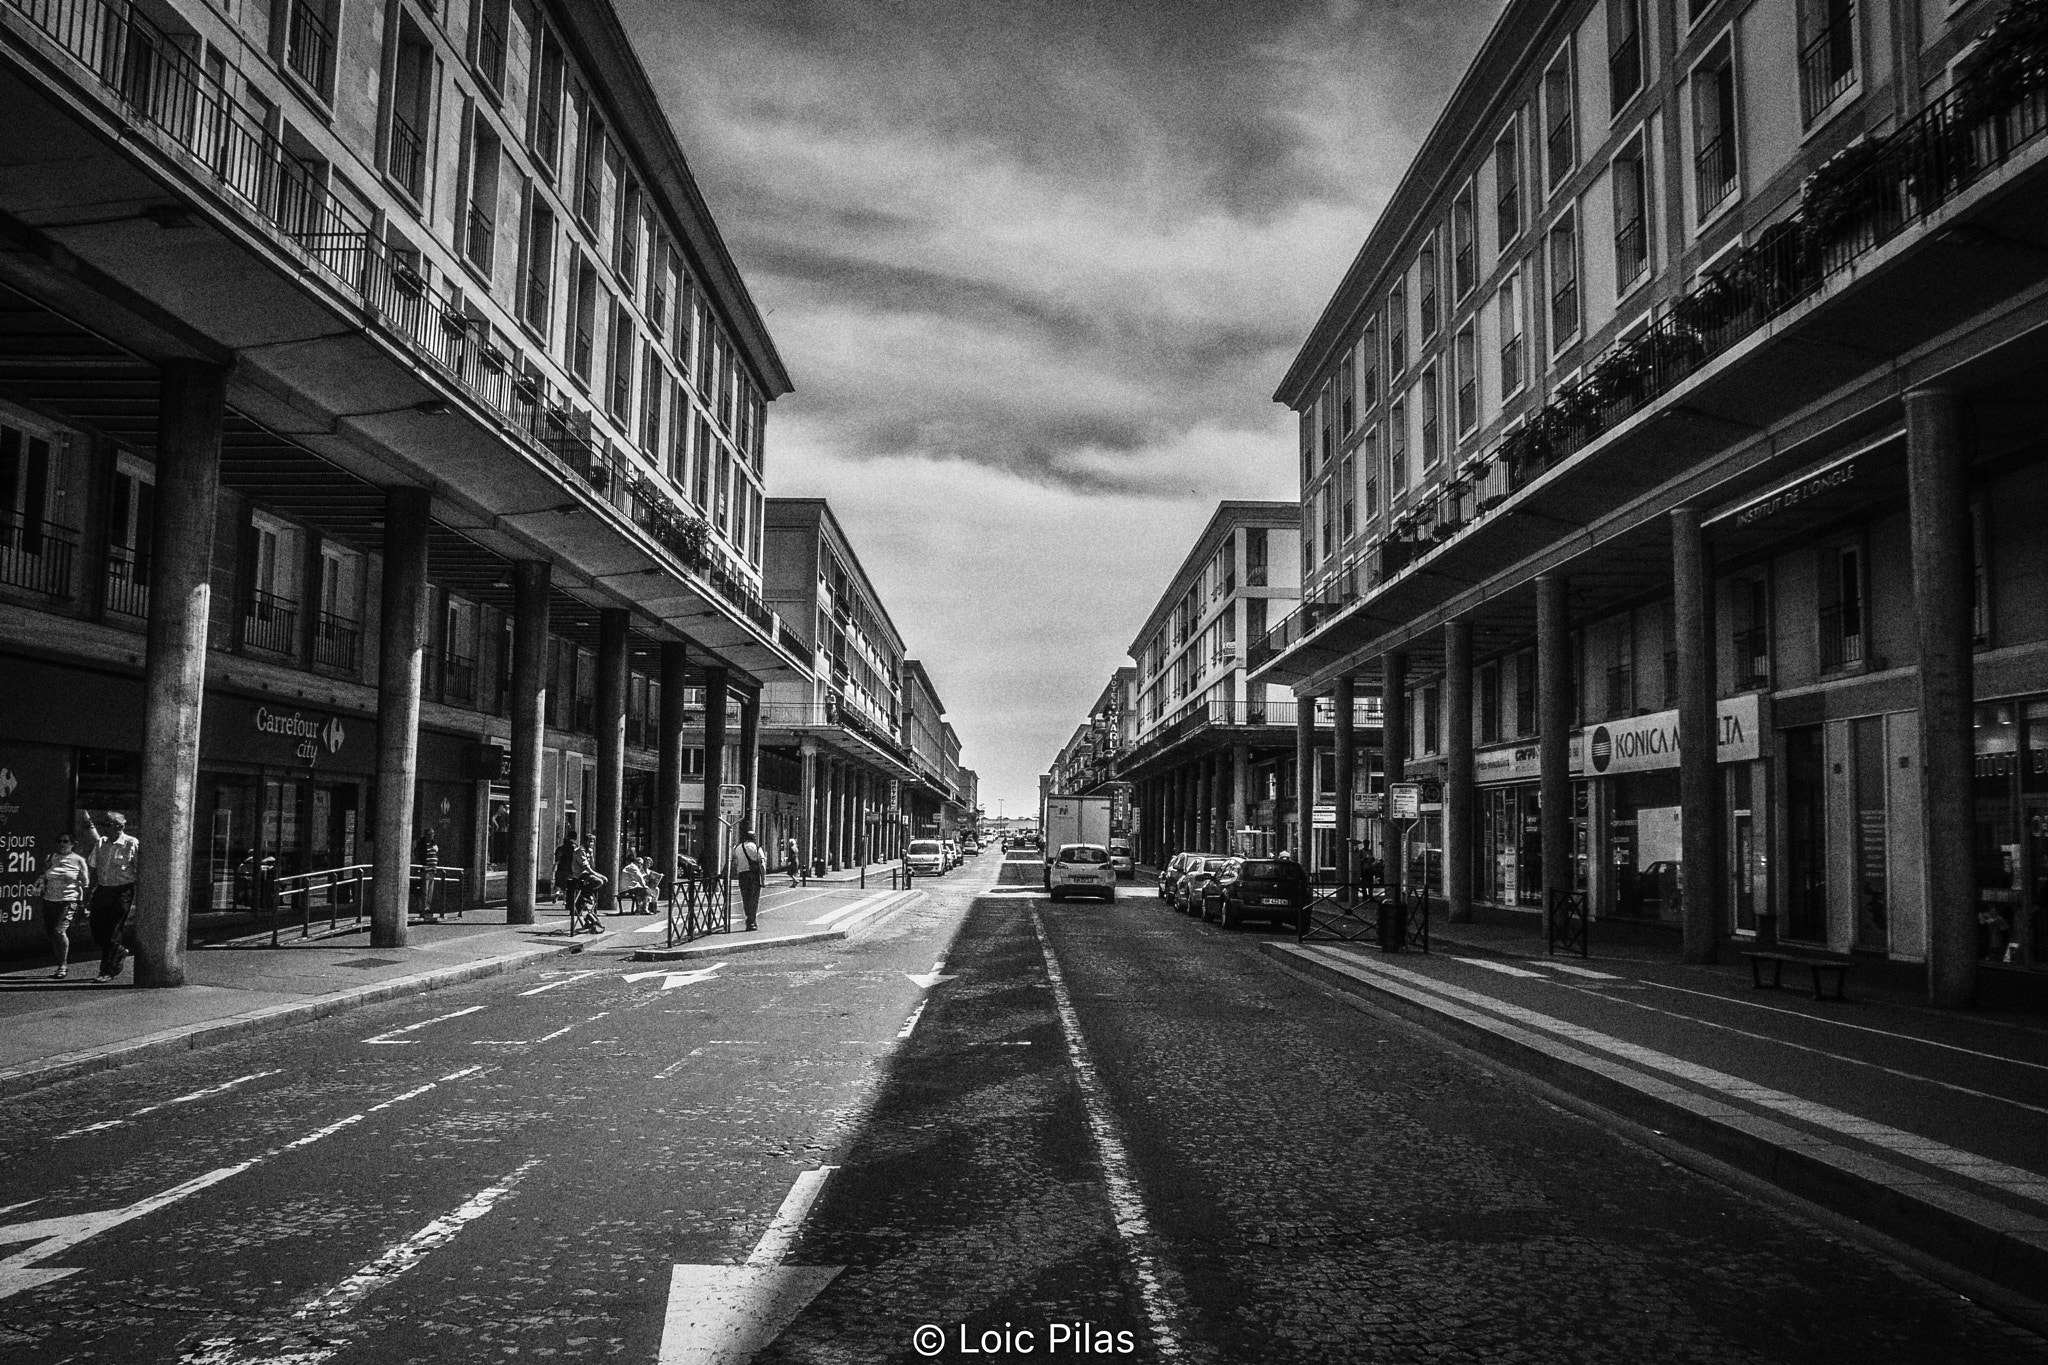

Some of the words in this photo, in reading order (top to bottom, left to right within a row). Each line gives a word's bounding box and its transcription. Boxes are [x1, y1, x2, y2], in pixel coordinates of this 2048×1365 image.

[1736, 496, 1782, 527] INSTITUT
[1784, 489, 1800, 507] DE
[1802, 464, 1855, 499] L'ONGLE
[257, 706, 319, 739] Carrefour
[297, 740, 318, 768] city
[1615, 728, 1669, 760] KONICA
[6, 831, 36, 852] jours
[8, 850, 36, 873] 21h
[11, 899, 33, 922] 9h
